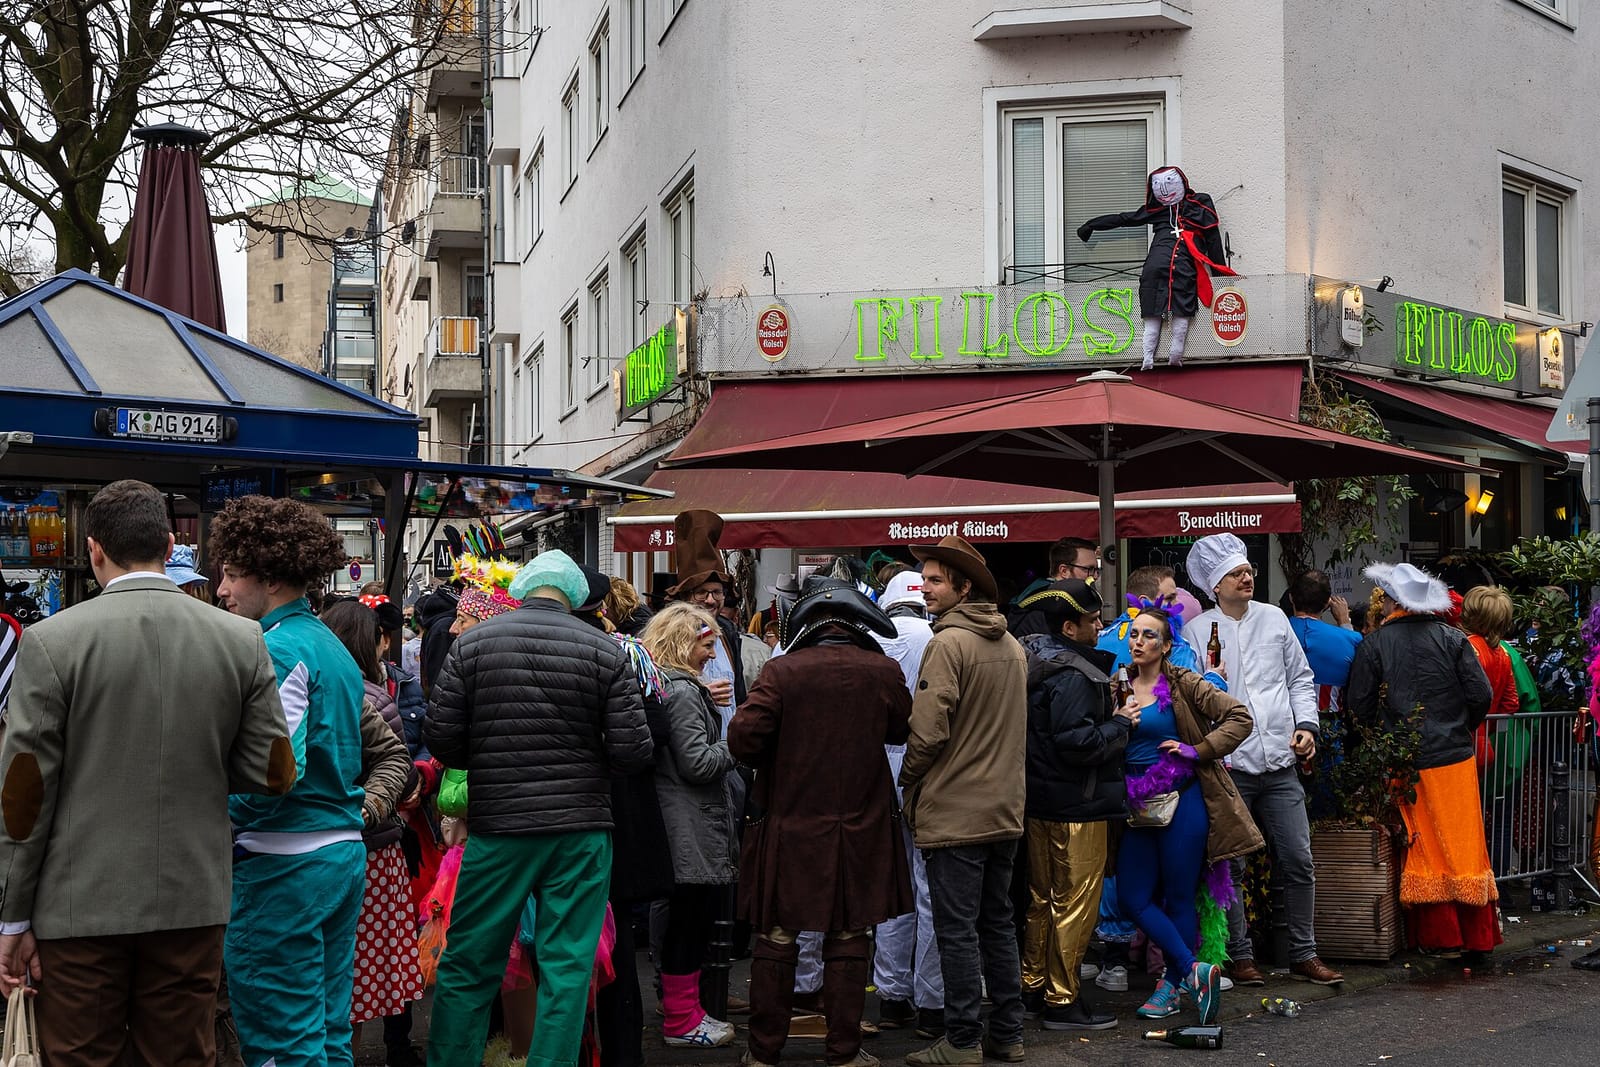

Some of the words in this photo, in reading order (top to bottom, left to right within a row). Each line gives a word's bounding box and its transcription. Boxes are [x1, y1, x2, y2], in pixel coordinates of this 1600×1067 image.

[853, 289, 1135, 361] FILOS
[1218, 323, 1241, 333] Kölsch
[1404, 301, 1517, 383] FILOS
[129, 412, 140, 432] K
[154, 414, 177, 434] AG
[182, 416, 215, 436] 914
[889, 521, 959, 540] Reissdorf
[962, 520, 1009, 539] Kölsch
[1177, 511, 1262, 532] Benediktiner
